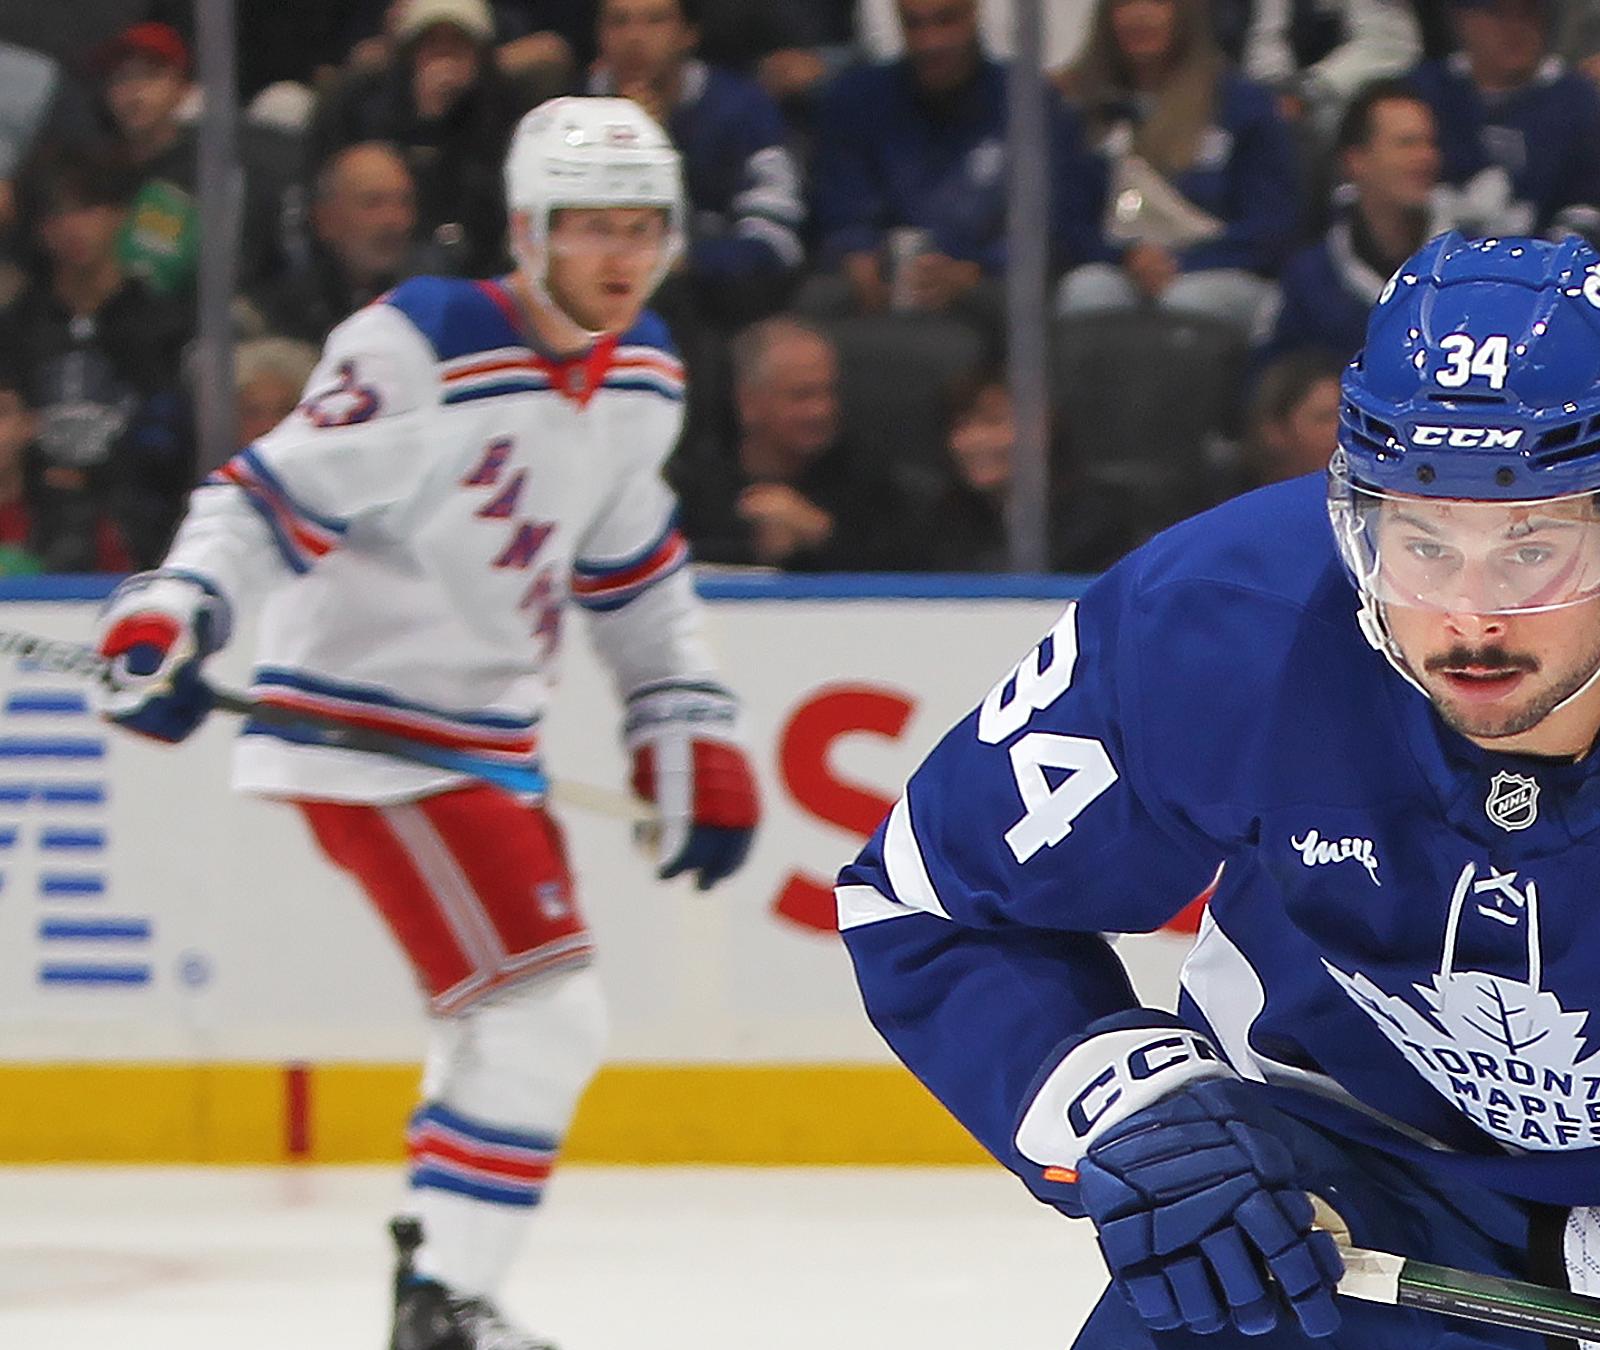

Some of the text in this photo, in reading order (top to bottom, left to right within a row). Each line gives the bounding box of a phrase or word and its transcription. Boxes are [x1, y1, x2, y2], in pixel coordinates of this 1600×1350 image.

[1435, 333, 1509, 389] 34
[1410, 424, 1524, 449] CCM
[978, 601, 1119, 864] 34
[1497, 789, 1530, 815] NHL
[1067, 1036, 1217, 1139] CC
